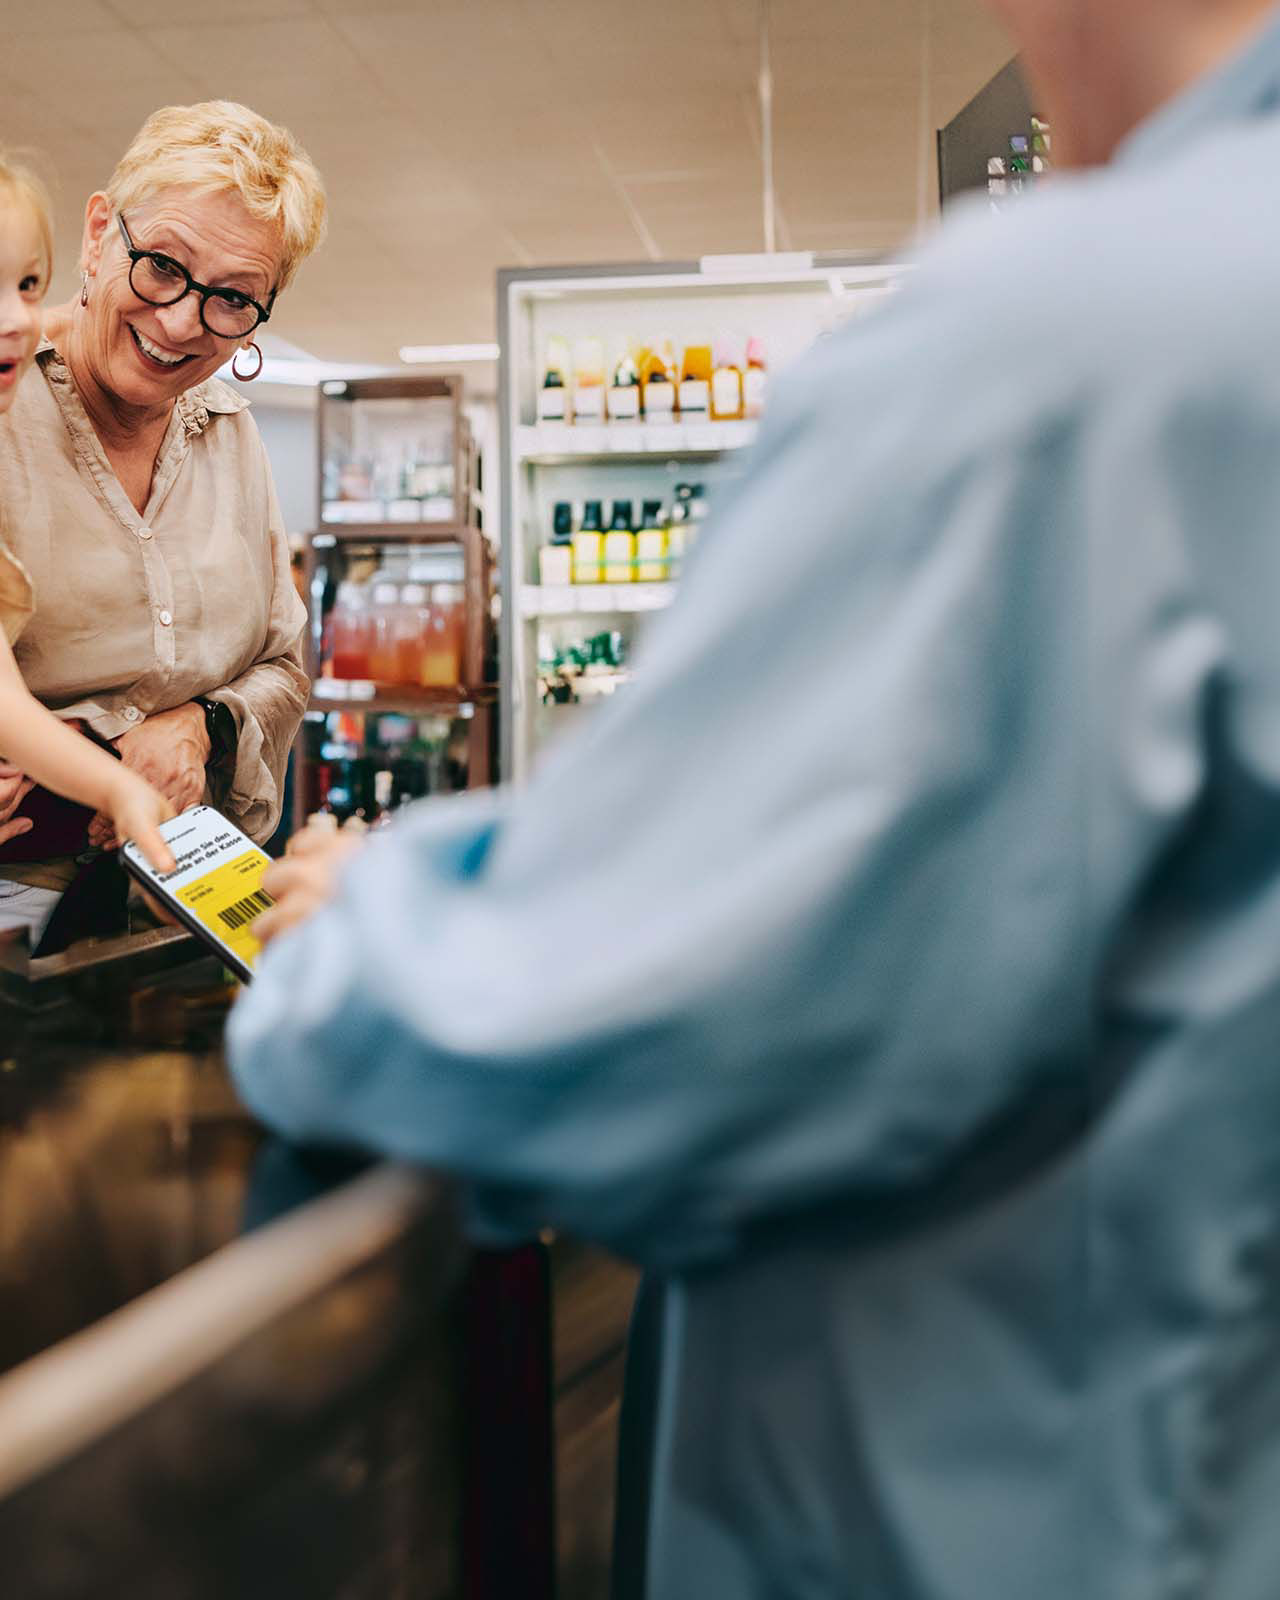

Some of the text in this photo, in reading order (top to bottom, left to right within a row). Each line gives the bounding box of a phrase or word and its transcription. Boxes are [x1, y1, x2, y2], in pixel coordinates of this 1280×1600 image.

[194, 856, 205, 865] an
[205, 848, 219, 858] der
[220, 836, 242, 850] Kasse
[200, 840, 213, 849] Sie
[214, 832, 230, 842] den
